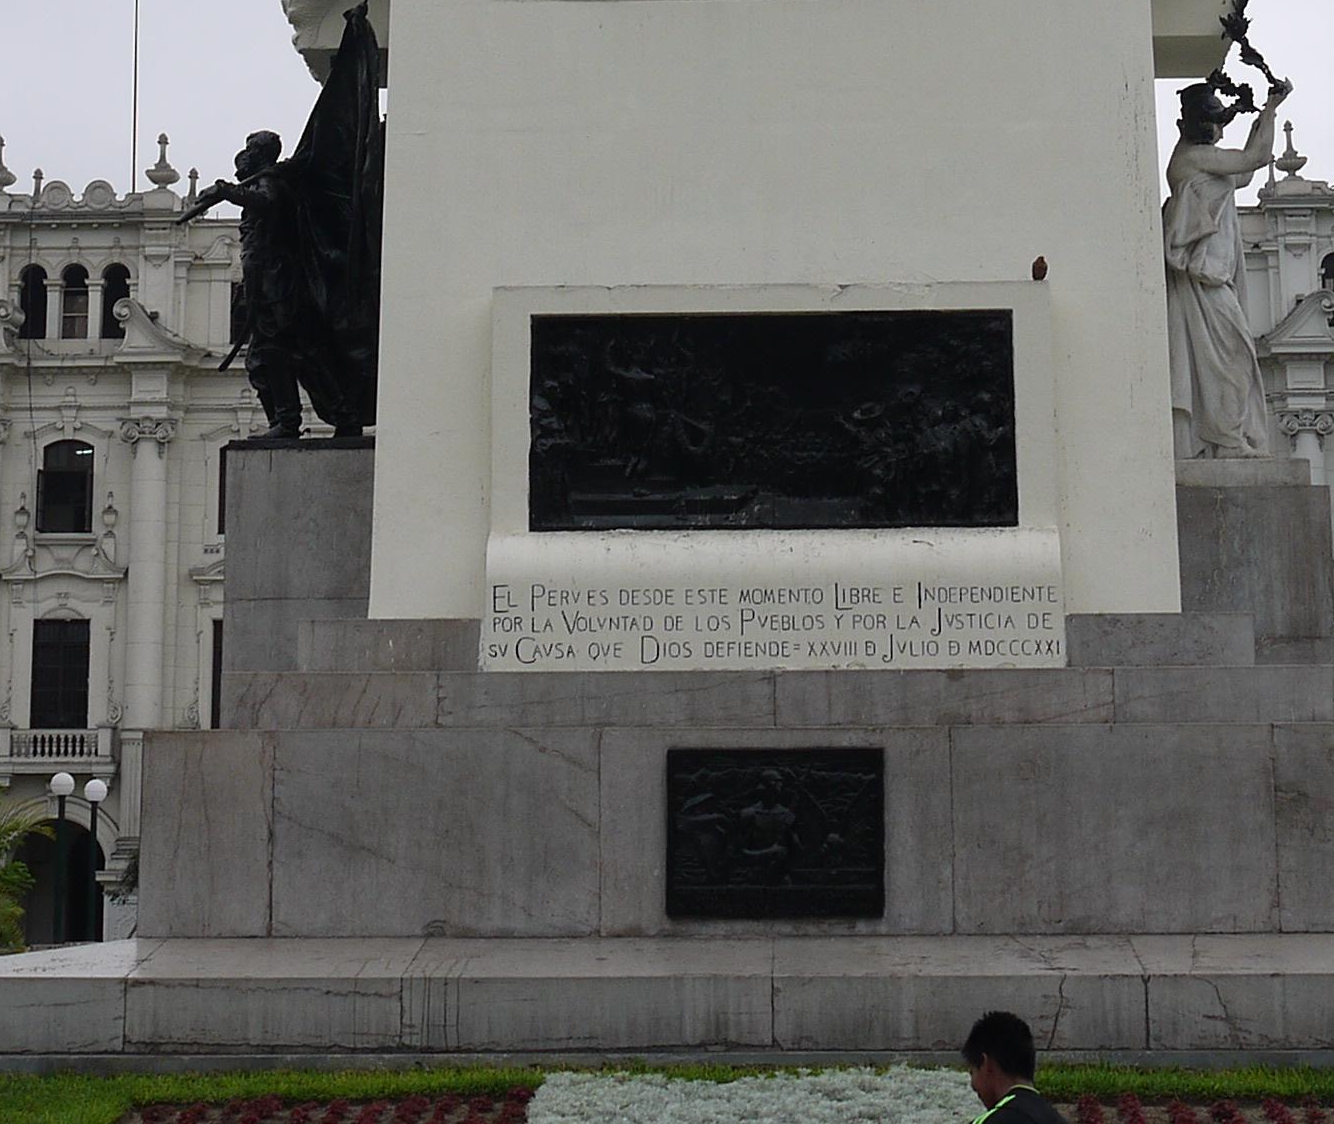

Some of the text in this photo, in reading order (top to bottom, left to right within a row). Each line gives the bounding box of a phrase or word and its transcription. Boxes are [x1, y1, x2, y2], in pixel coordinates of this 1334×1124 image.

[493, 584, 518, 613] EL
[587, 589, 609, 606] ES
[619, 588, 676, 606] DESDE
[685, 588, 729, 605] ESTE
[738, 587, 824, 605] MOMENTO
[835, 582, 882, 610] LIBRE
[893, 587, 903, 603] E
[918, 581, 1058, 609] INDEPENDIENTE
[492, 616, 523, 633] POR
[531, 616, 554, 633] LA
[664, 615, 683, 632] DE
[695, 615, 731, 632] LOS
[834, 613, 844, 629] Y
[852, 613, 887, 630] POR
[896, 614, 921, 630] LA
[1027, 612, 1053, 630] DE
[640, 635, 693, 664] DIOS
[968, 640, 1061, 658] MDCCCXXI
